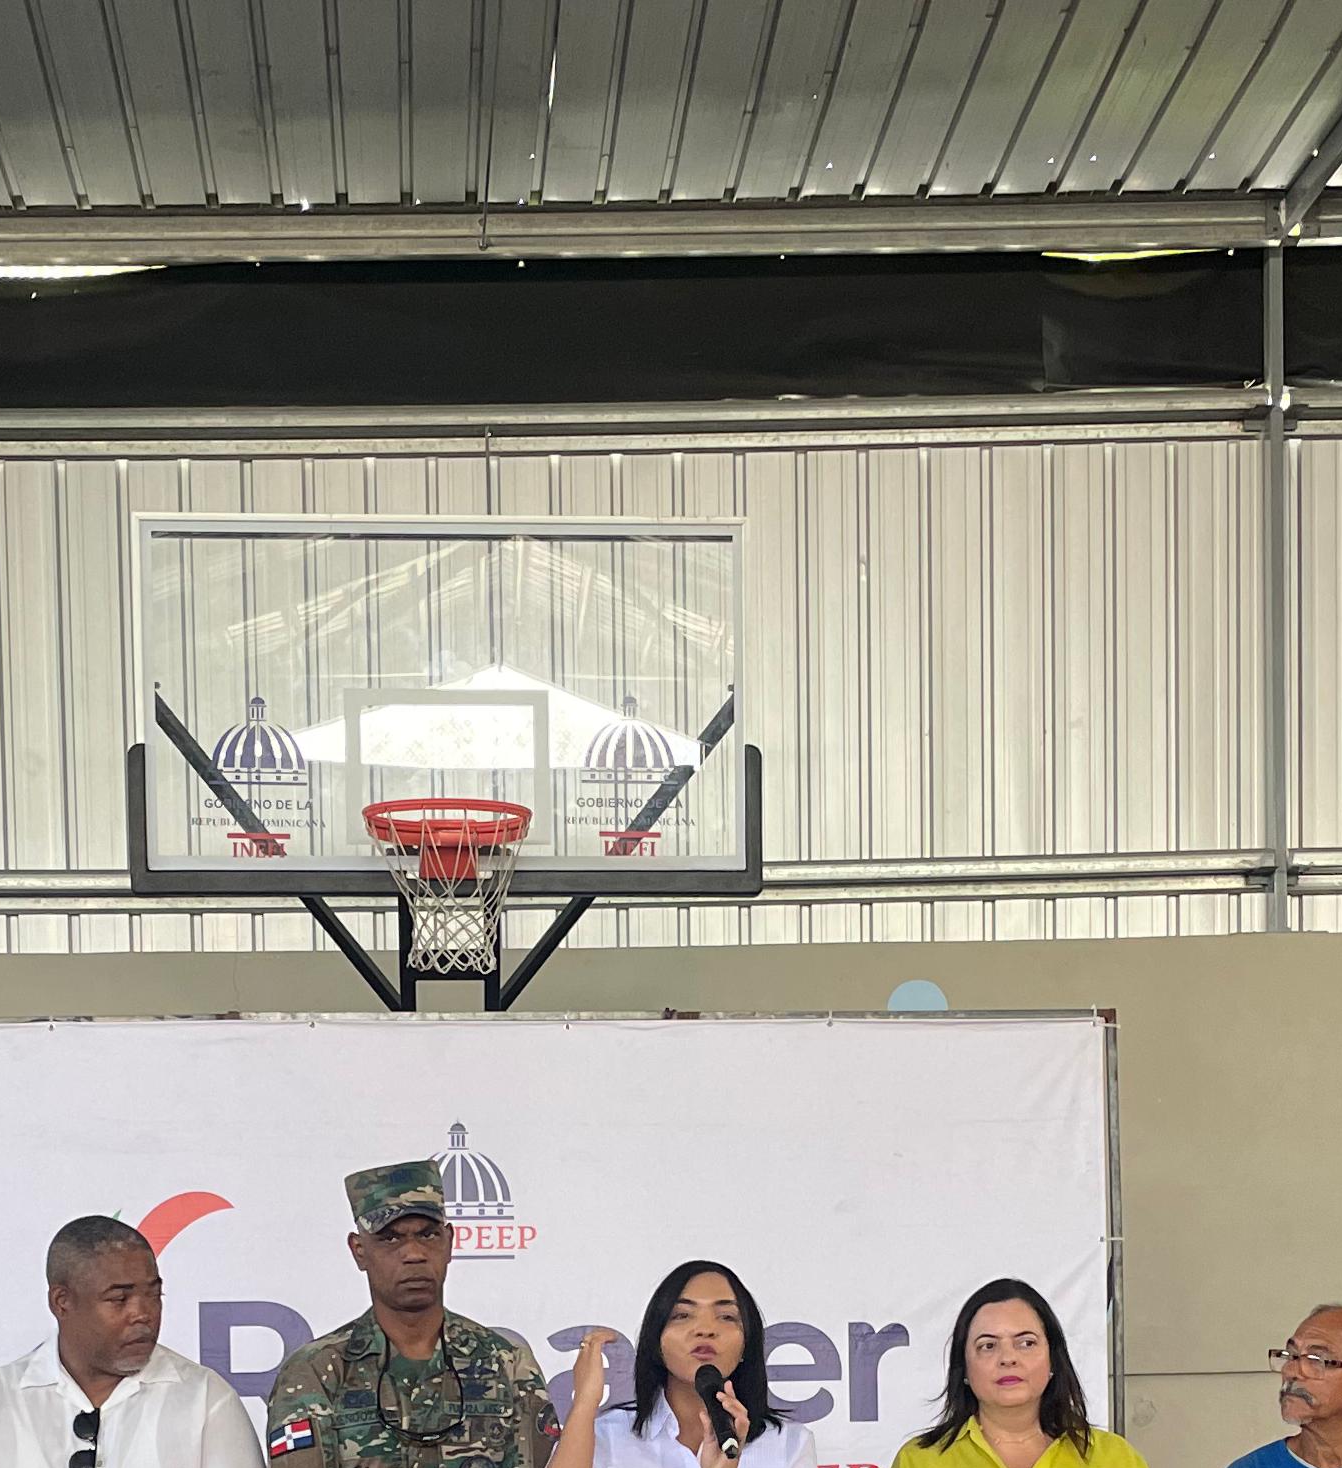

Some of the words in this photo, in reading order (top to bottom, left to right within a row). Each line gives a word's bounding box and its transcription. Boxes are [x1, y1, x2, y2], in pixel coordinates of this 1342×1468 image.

[276, 799, 293, 810] DE
[296, 800, 313, 811] LA
[576, 797, 643, 809] GOBIERNO
[453, 1225, 538, 1250] PEEP
[199, 1300, 910, 1425] Raer
